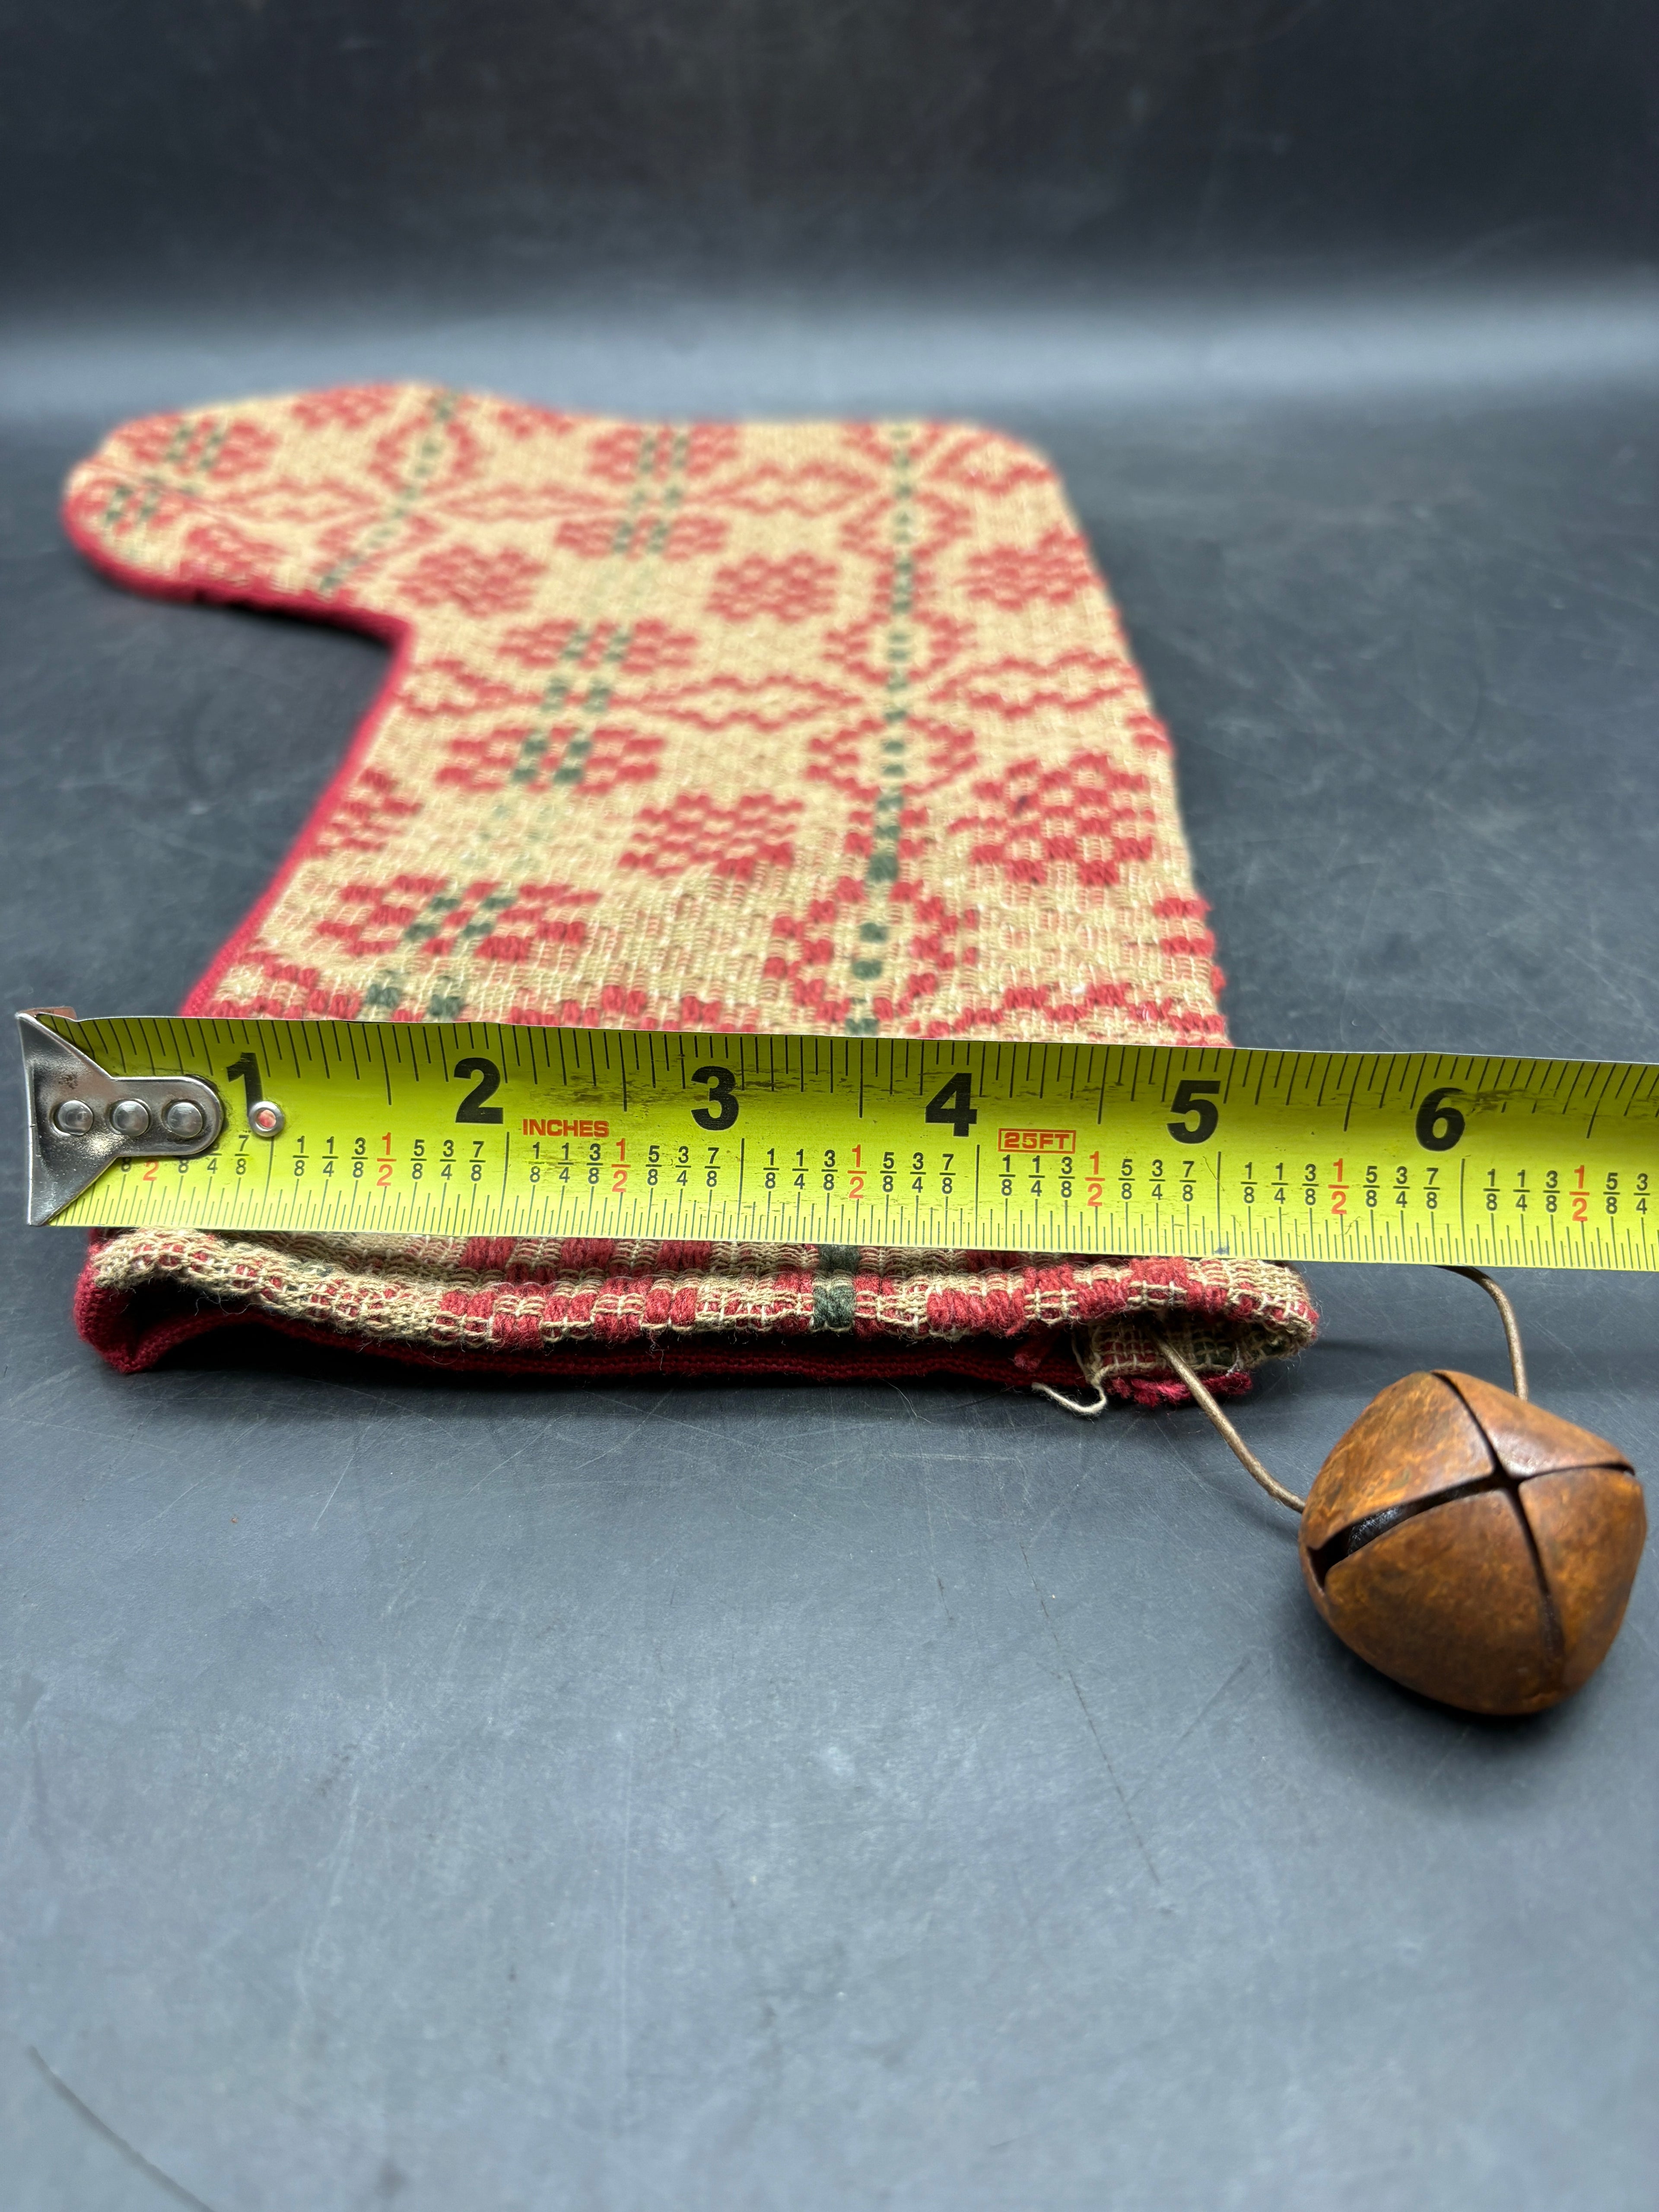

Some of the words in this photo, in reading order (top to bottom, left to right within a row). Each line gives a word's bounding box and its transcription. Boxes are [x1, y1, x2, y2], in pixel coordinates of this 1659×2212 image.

[226, 1052, 263, 1117] 1
[454, 1057, 503, 1124] 2
[691, 1065, 740, 1131] 3
[925, 1073, 978, 1137] 4
[1166, 1080, 1221, 1144] 5
[523, 1119, 610, 1138] INCHES
[1004, 1131, 1070, 1150] 25FT
[1415, 1087, 1466, 1151] 6
